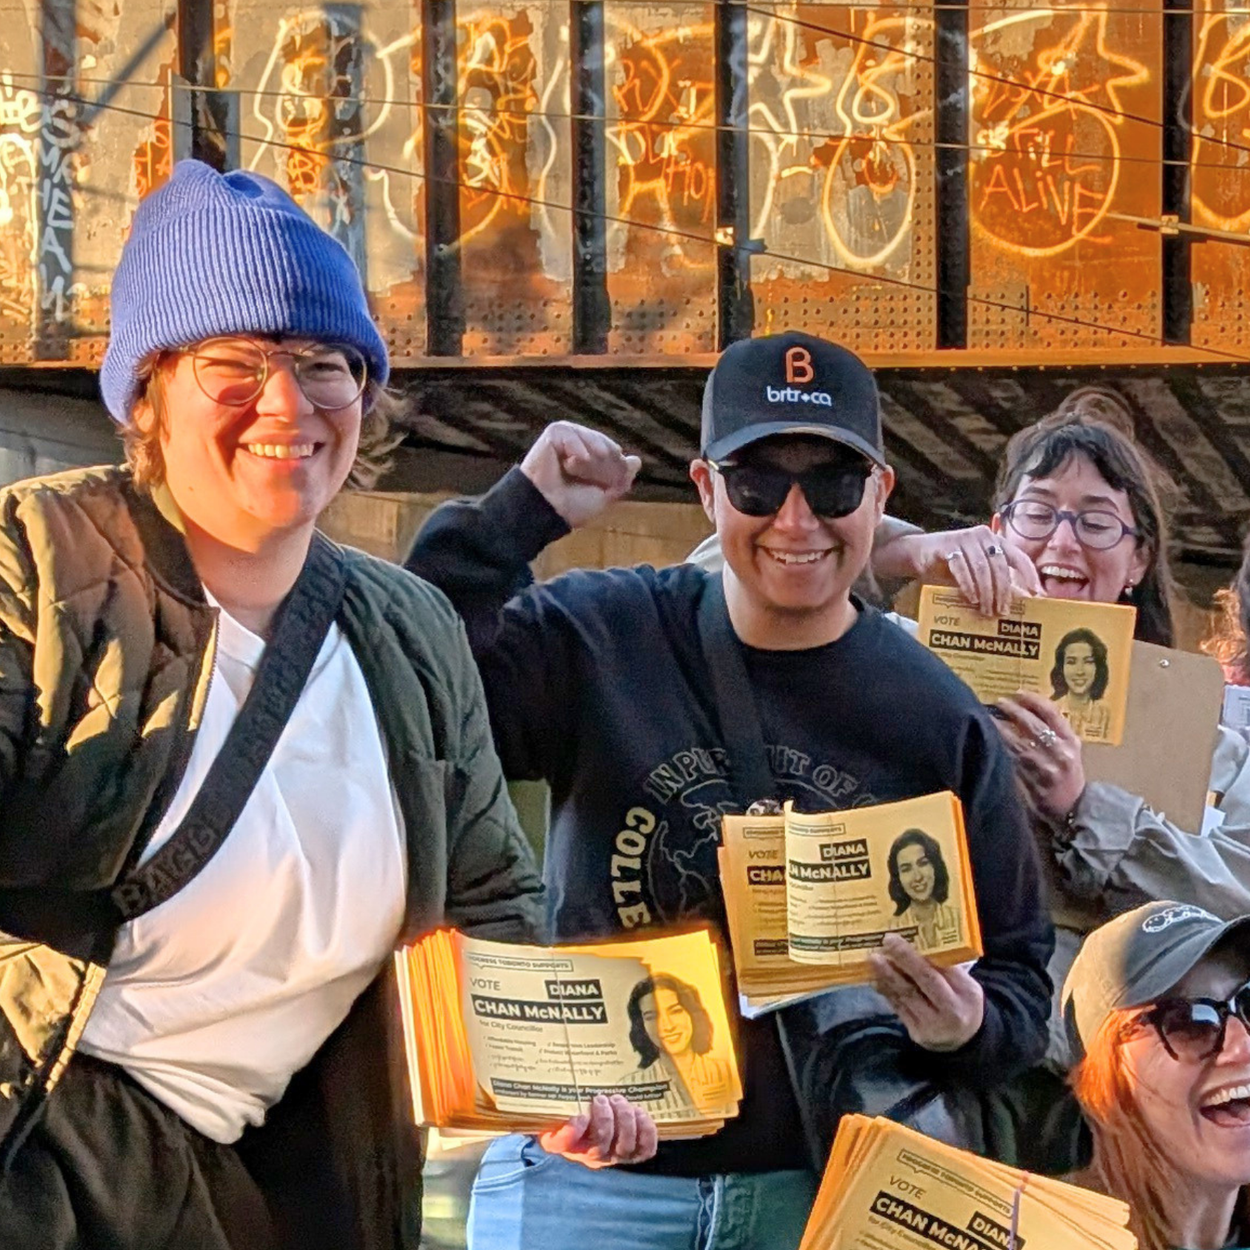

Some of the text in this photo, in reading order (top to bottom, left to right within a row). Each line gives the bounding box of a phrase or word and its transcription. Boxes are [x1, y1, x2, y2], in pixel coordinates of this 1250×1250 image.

[785, 346, 815, 383] B
[934, 615, 960, 626] VOTE
[1001, 623, 1039, 637] DIANA
[931, 633, 1038, 656] CHAN McNALLY
[748, 849, 779, 859] VOTE
[823, 843, 865, 858] DIANA
[800, 863, 868, 879] McNALLY
[470, 977, 501, 991] VOTE
[549, 983, 600, 996] DIANA
[474, 1000, 604, 1020] CHAN McNALLY
[889, 1175, 927, 1200] VOTE
[876, 1197, 929, 1232] CHAN
